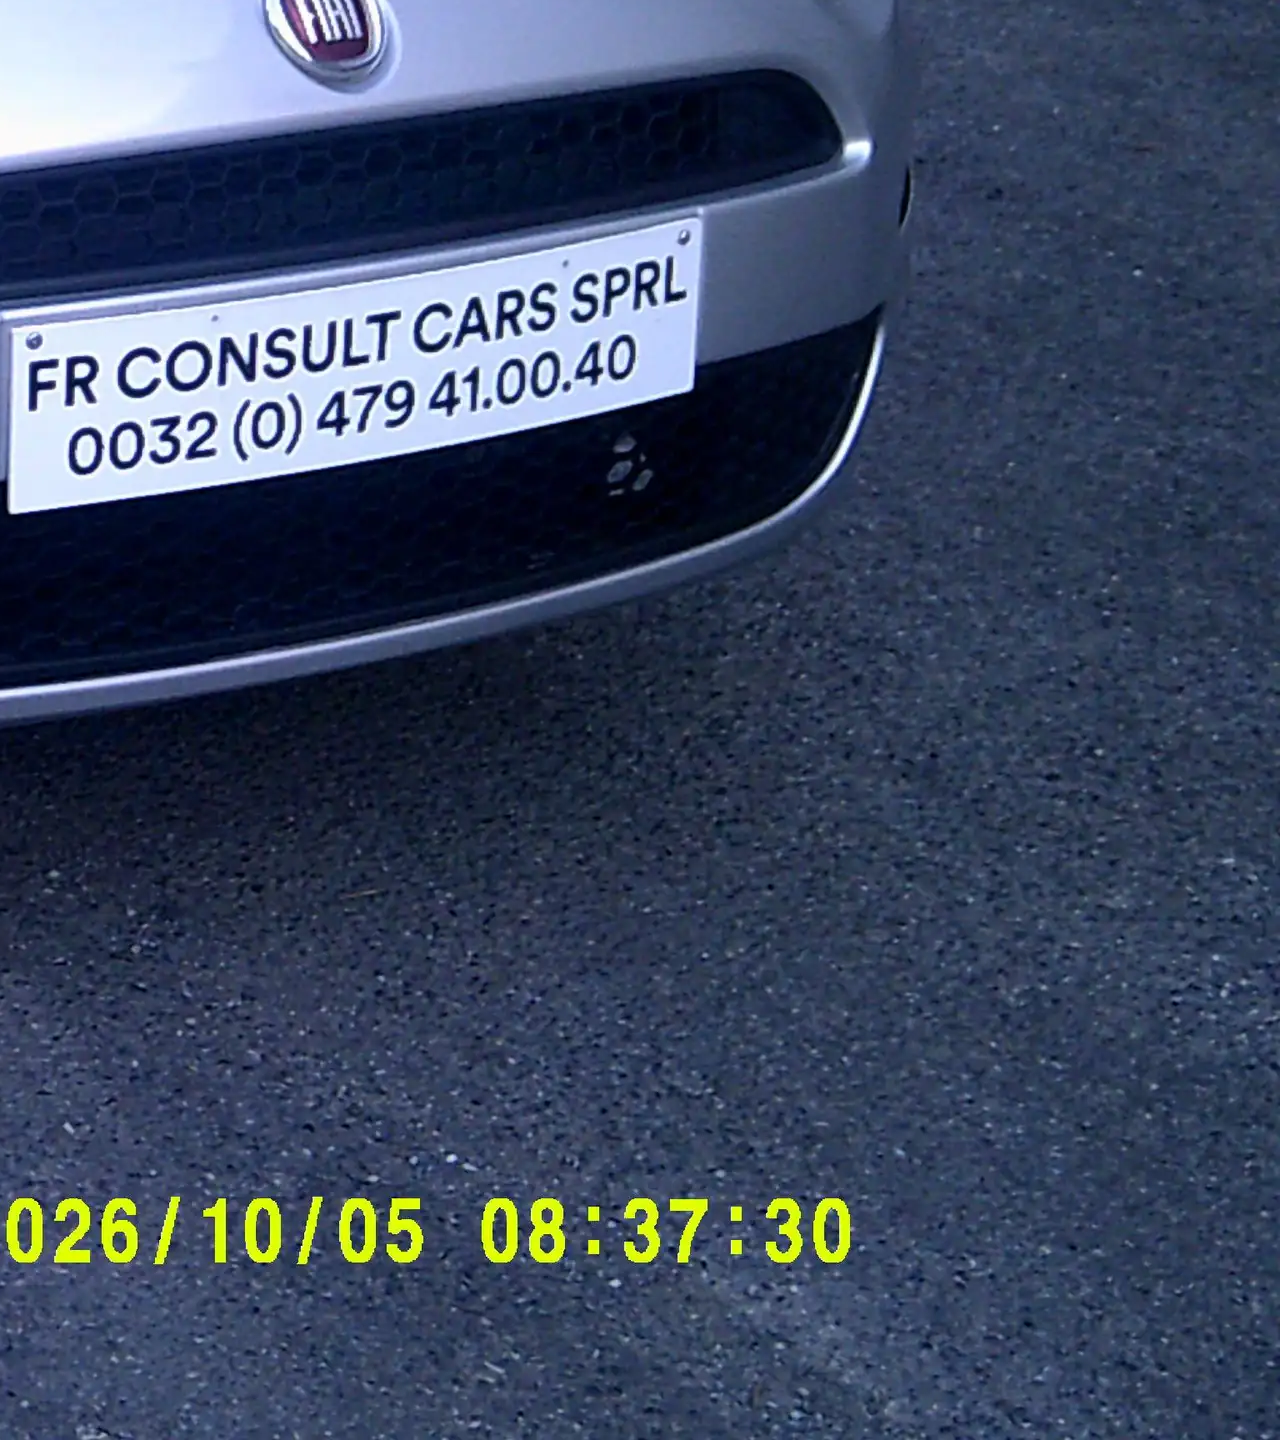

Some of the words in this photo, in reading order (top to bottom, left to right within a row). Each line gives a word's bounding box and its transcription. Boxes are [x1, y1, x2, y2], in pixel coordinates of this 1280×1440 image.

[28, 356, 100, 412] FR
[118, 310, 402, 399] CONSULT
[414, 282, 558, 353] CARS
[570, 255, 687, 324] SPRL
[68, 411, 218, 476] 0032
[233, 393, 302, 462] (0)
[316, 379, 415, 437] 479
[428, 334, 636, 417] 41.00.40
